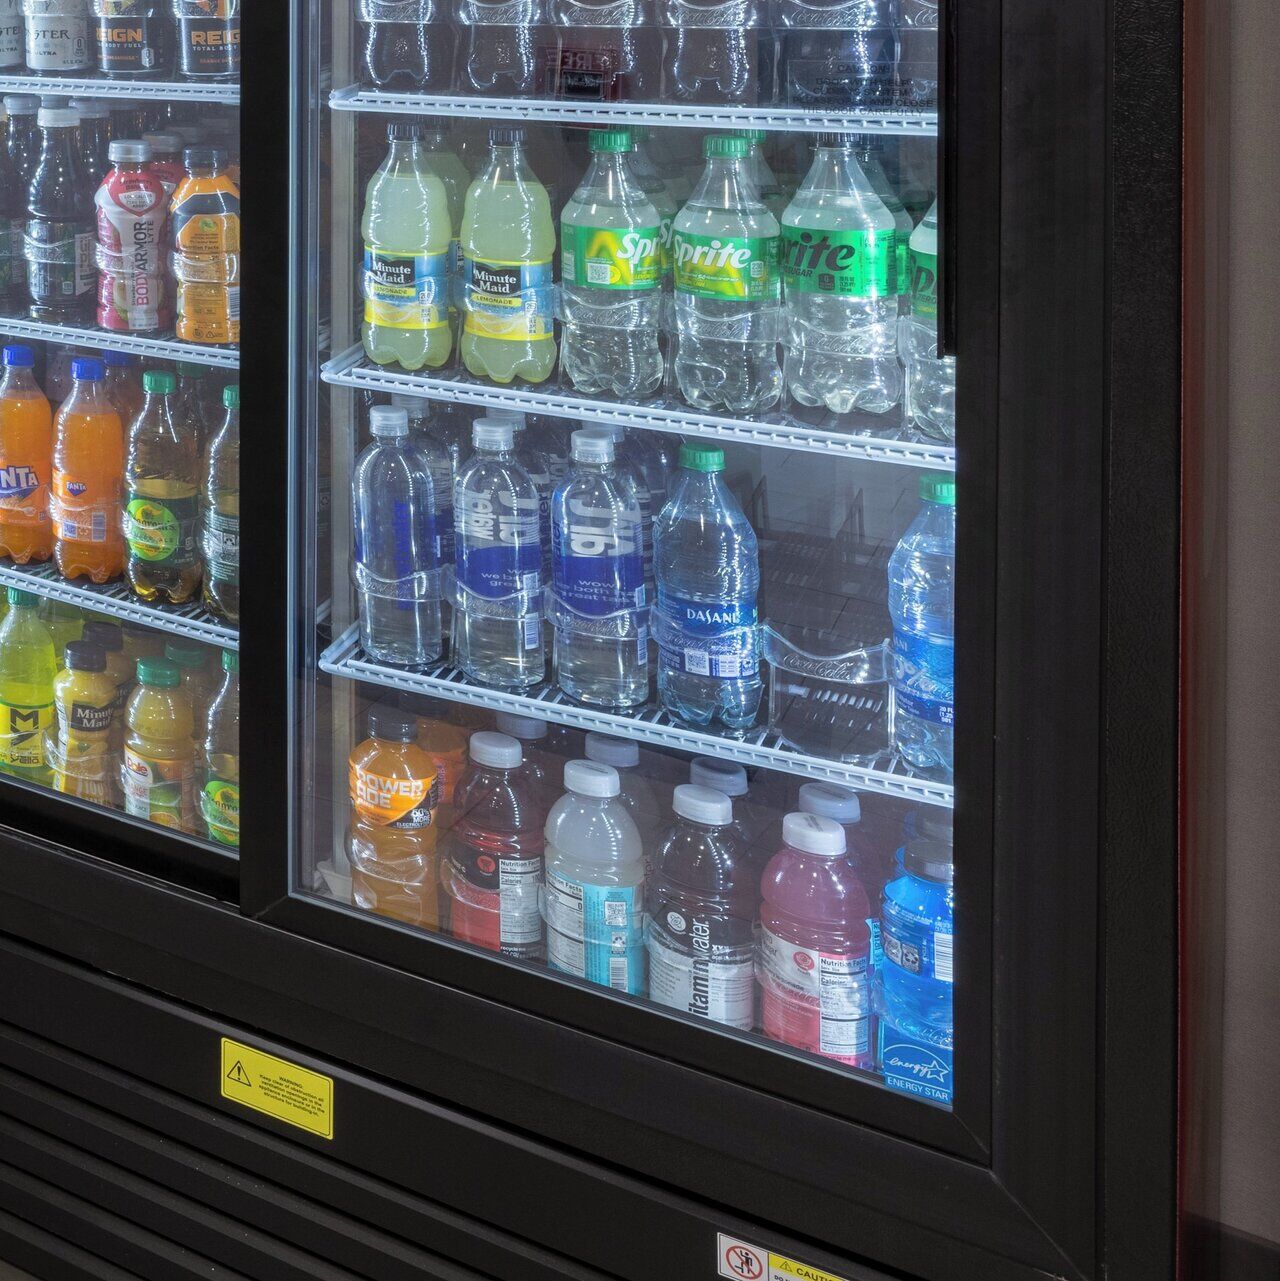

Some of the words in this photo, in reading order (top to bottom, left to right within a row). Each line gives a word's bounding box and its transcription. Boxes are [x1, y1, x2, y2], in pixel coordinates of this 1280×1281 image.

[896, 99, 934, 107] CLOSE
[674, 234, 751, 269] Sprite
[134, 221, 149, 306] BODYARMOR
[372, 261, 411, 275] Minute
[377, 272, 405, 284] Maid
[473, 269, 516, 285] Minute
[480, 281, 510, 294] Maid
[476, 296, 513, 305] LEMONADE
[66, 482, 87, 492] FANTA
[687, 608, 742, 624] DASANI
[128, 758, 148, 776] Dole
[357, 771, 423, 796] POWER
[356, 782, 391, 808] ADE
[565, 882, 583, 892] Facts
[820, 959, 851, 967] Nutrition
[890, 1056, 928, 1074] energy
[888, 1078, 924, 1094] ENERGY
[925, 1086, 948, 1100] STAR
